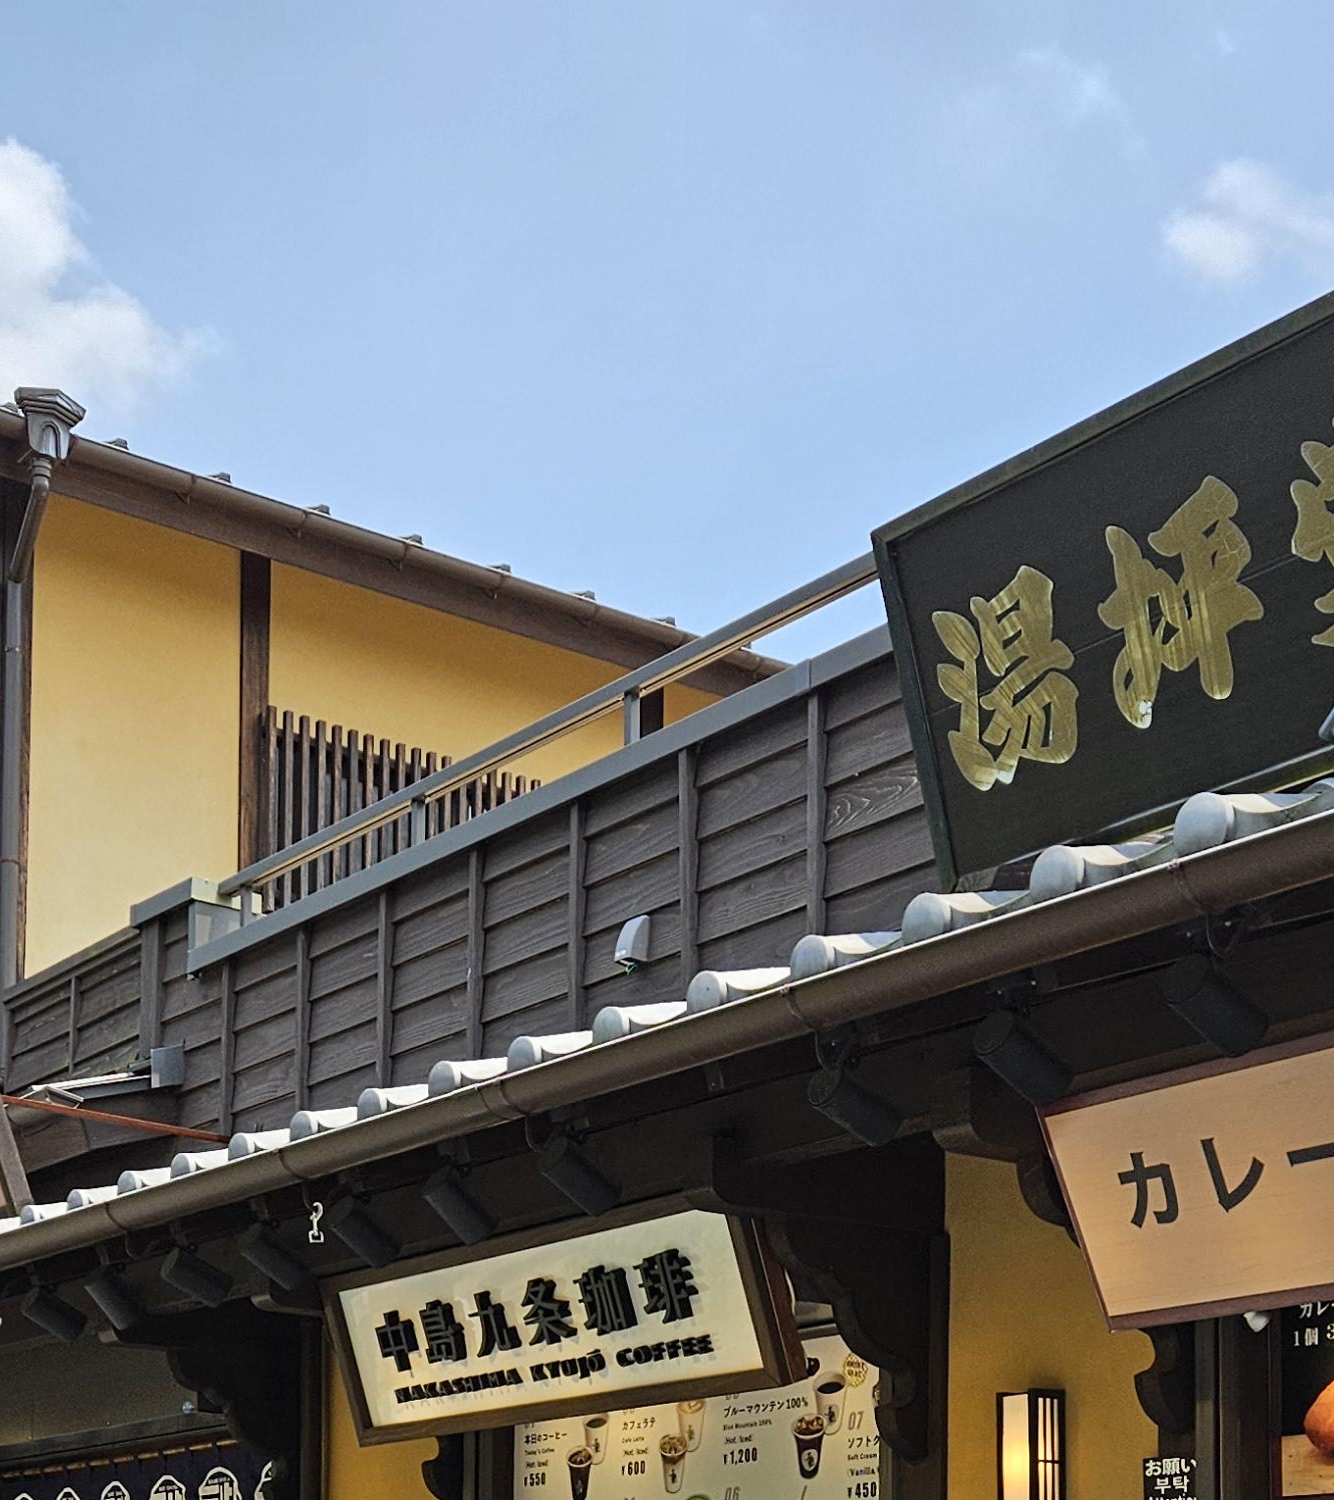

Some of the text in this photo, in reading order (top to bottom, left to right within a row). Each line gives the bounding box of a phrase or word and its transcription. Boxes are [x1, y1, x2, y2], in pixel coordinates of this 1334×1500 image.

[374, 1247, 700, 1373] 中島九条珈琲
[394, 1367, 524, 1405] NAKASHIMA
[616, 1333, 715, 1368] COFFEE
[621, 1416, 656, 1431] カフェラテ
[847, 1411, 865, 1431] 07
[723, 1448, 758, 1466] ¥1,200
[621, 1460, 646, 1476] ¥600
[1145, 1457, 1198, 1477] お願い
[523, 1472, 547, 1487] ¥550
[1154, 1475, 1190, 1495] 부탁
[847, 1481, 878, 1499] ¥450
